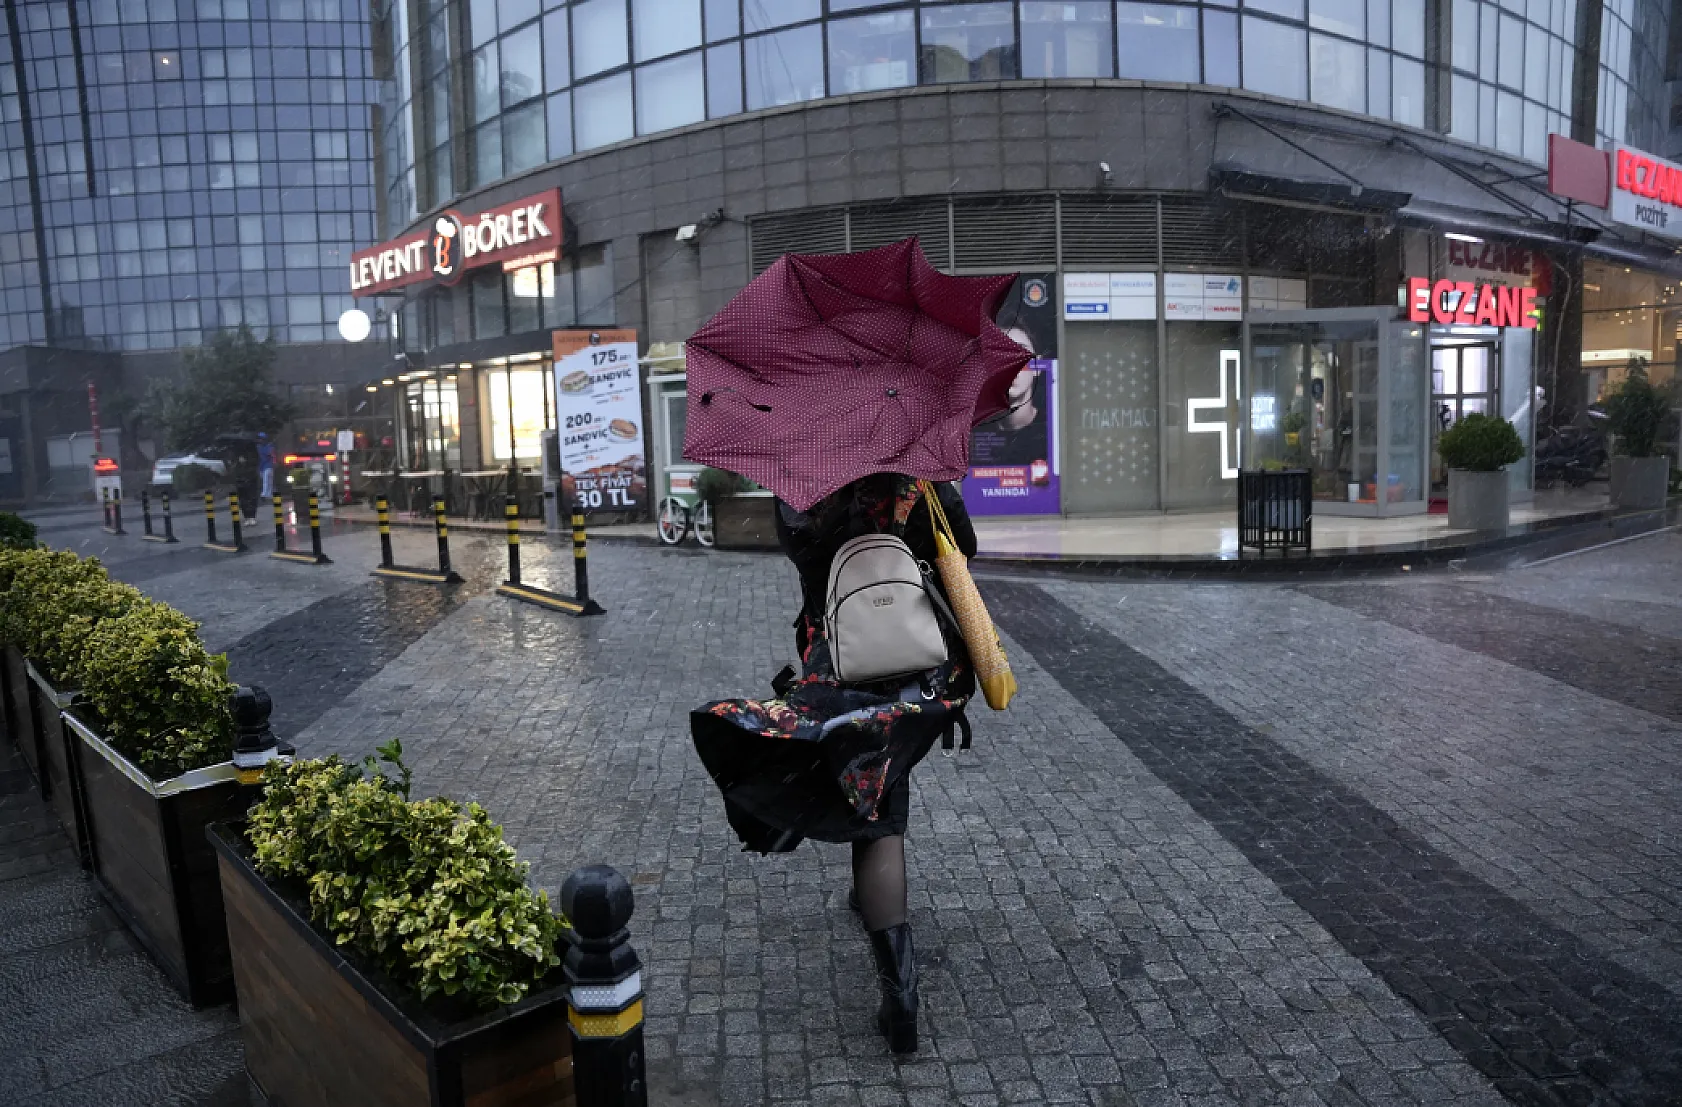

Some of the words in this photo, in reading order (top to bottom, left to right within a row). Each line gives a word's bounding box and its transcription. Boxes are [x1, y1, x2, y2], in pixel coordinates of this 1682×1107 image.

[350, 240, 428, 290] LEVENT
[463, 202, 552, 259] BÖREK
[1408, 276, 1538, 329] ECZANE
[590, 349, 618, 366] 175
[566, 412, 592, 429] 200
[607, 488, 636, 506] TL
